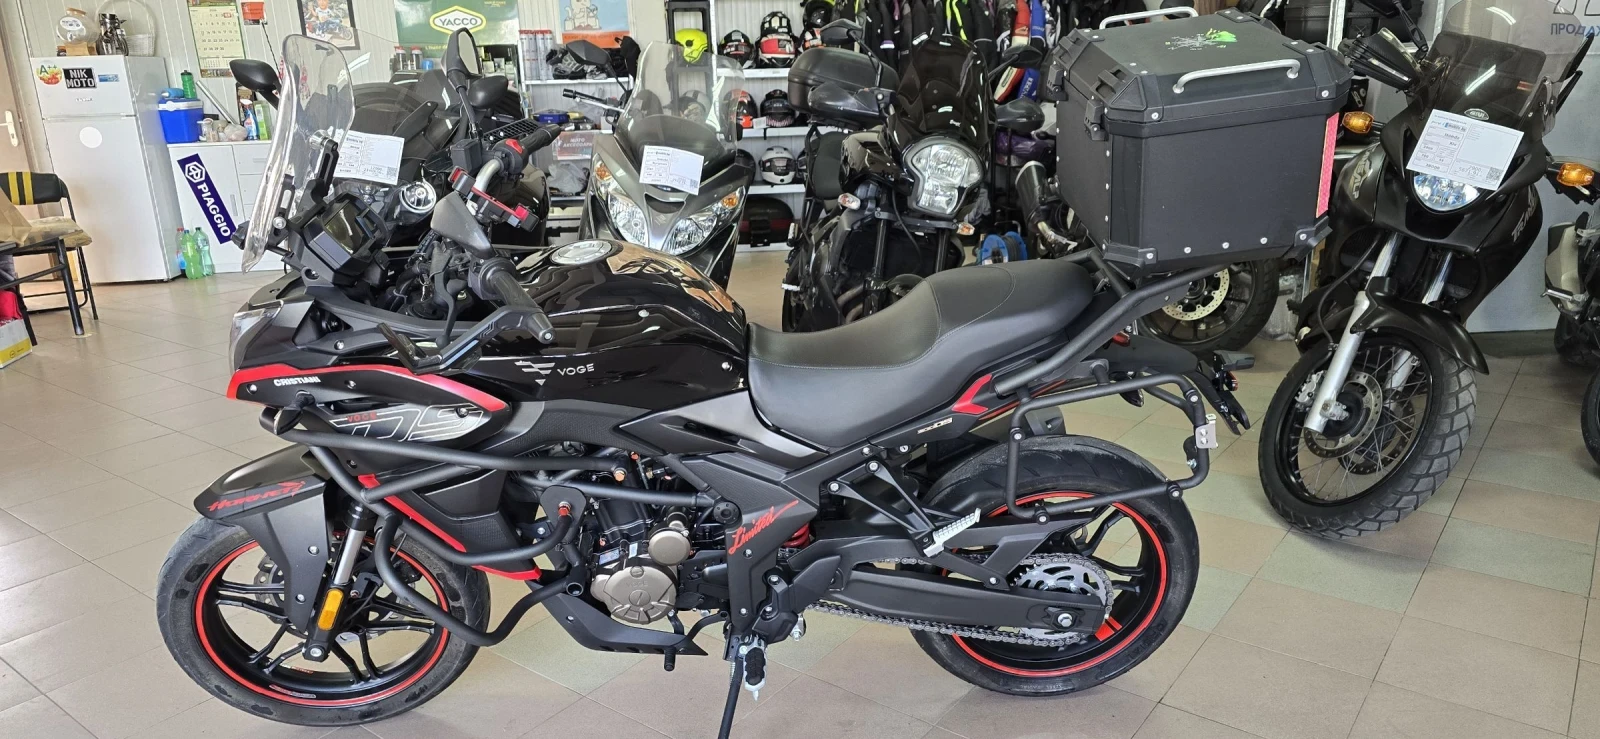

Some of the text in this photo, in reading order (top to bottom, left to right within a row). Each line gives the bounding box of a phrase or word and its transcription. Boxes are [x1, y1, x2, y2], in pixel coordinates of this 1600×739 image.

[439, 17, 478, 26] YACCO
[69, 69, 88, 79] NIK
[66, 78, 95, 88] MOTO
[197, 182, 231, 237] PIAGGIO
[557, 363, 595, 376] VOGE
[273, 376, 321, 387] CRISTIANI
[347, 411, 378, 423] VOGE
[728, 499, 799, 555] Limited
